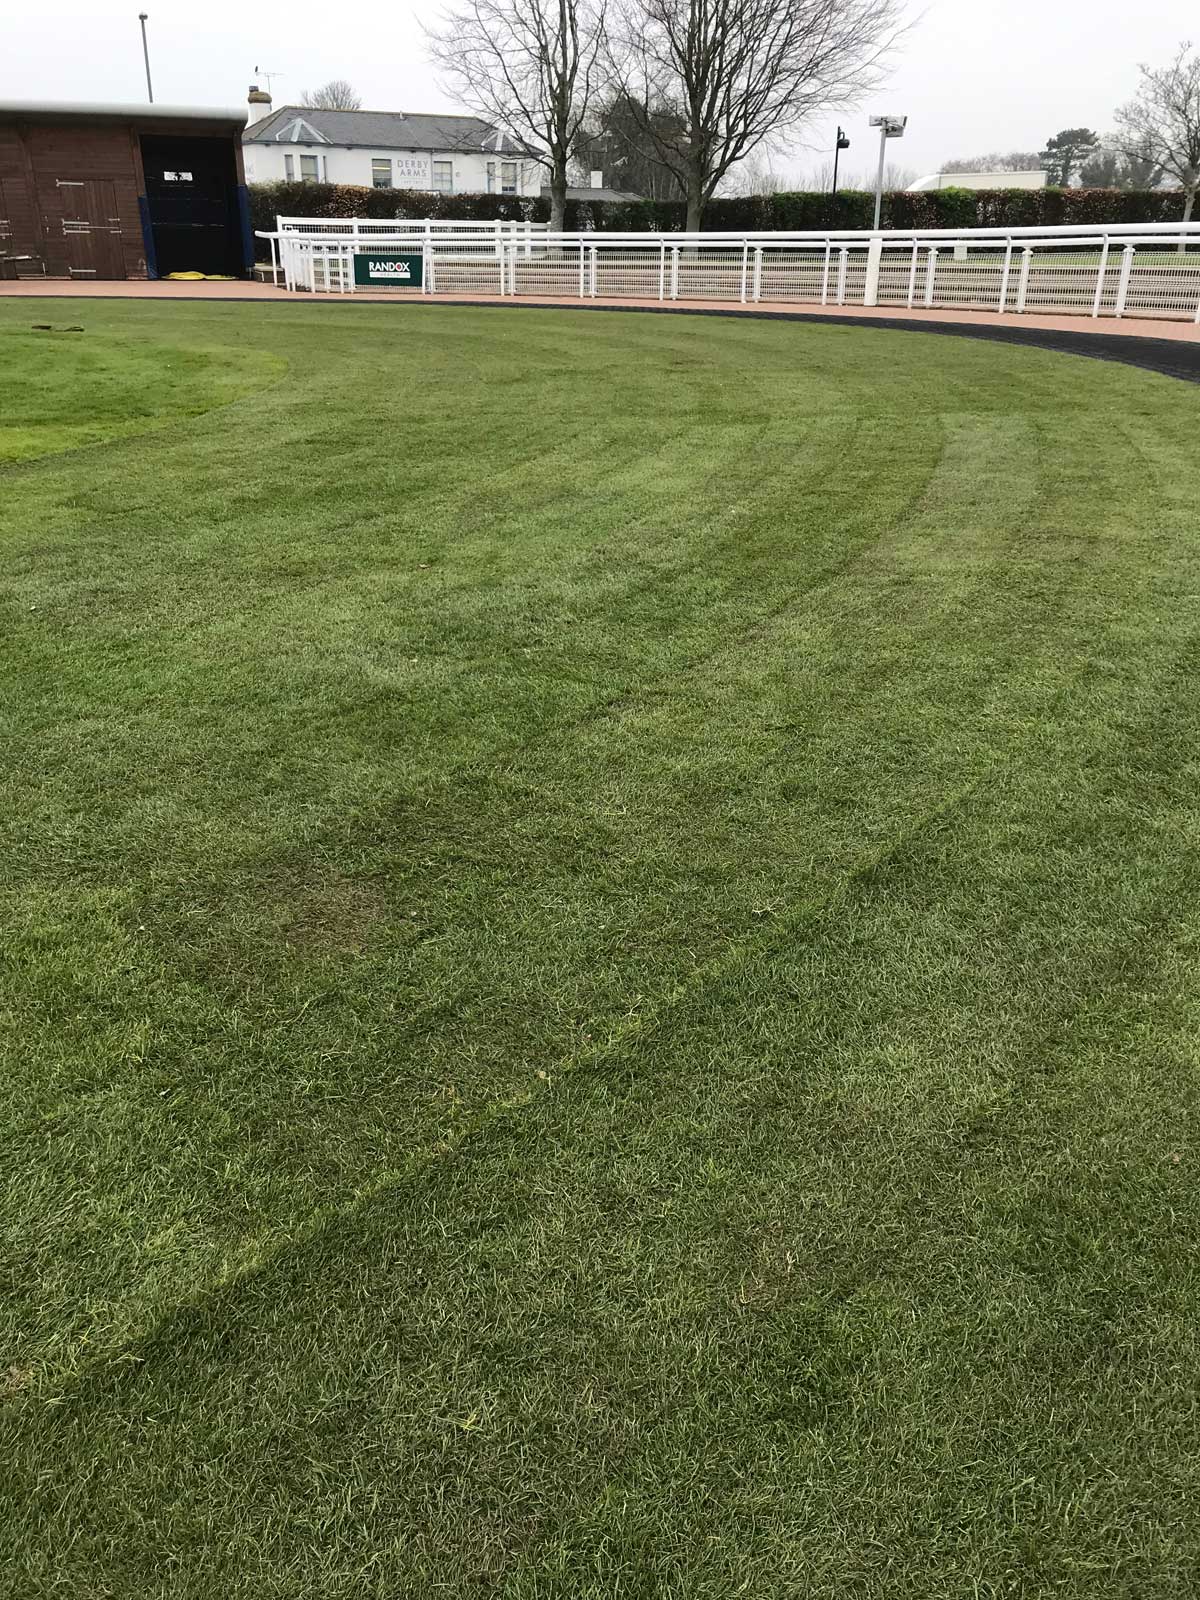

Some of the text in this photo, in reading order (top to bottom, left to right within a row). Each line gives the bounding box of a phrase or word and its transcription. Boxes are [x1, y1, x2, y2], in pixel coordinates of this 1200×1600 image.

[397, 159, 429, 168] DERBY
[400, 169, 427, 177] ARMS
[369, 261, 410, 272] RANDOX
